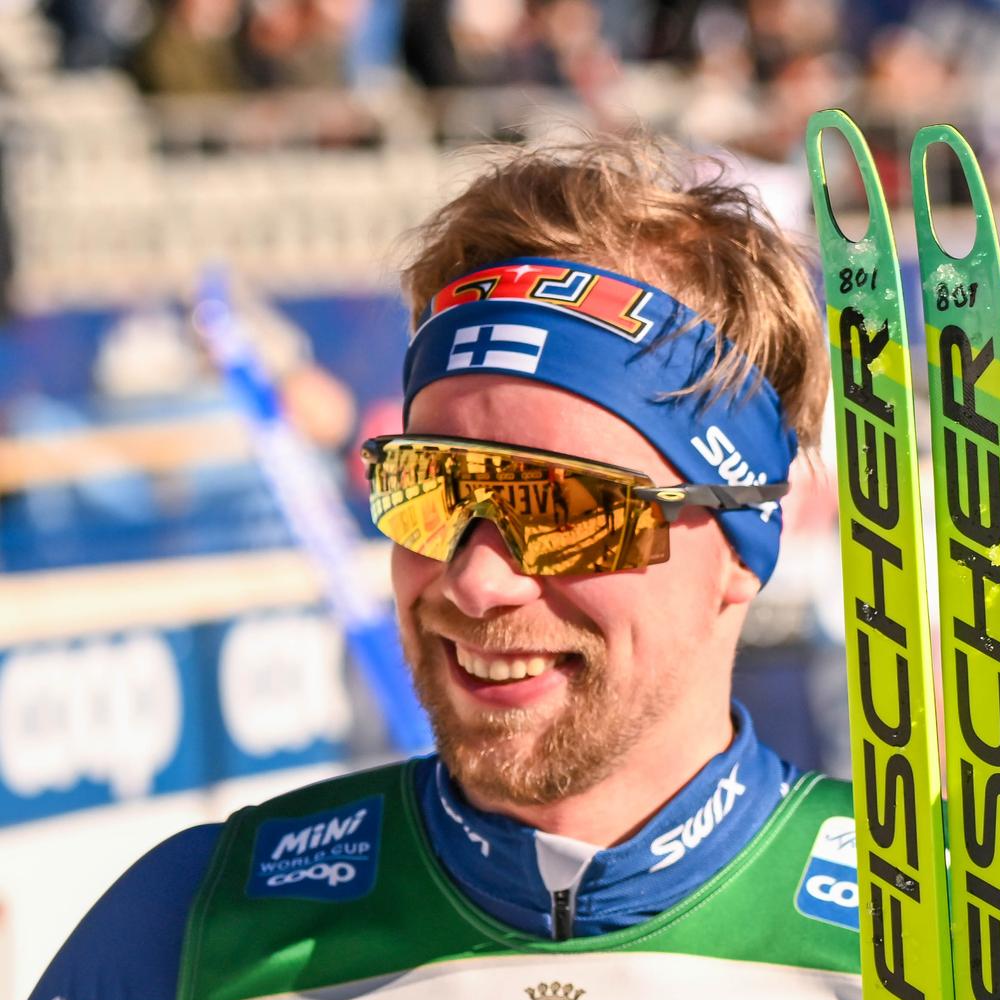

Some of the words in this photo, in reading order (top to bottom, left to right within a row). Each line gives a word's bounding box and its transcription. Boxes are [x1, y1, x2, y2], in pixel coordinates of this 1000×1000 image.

[839, 267, 878, 294] 801
[936, 282, 978, 311] 801
[331, 841, 370, 855] CUP
[267, 861, 356, 887] coop
